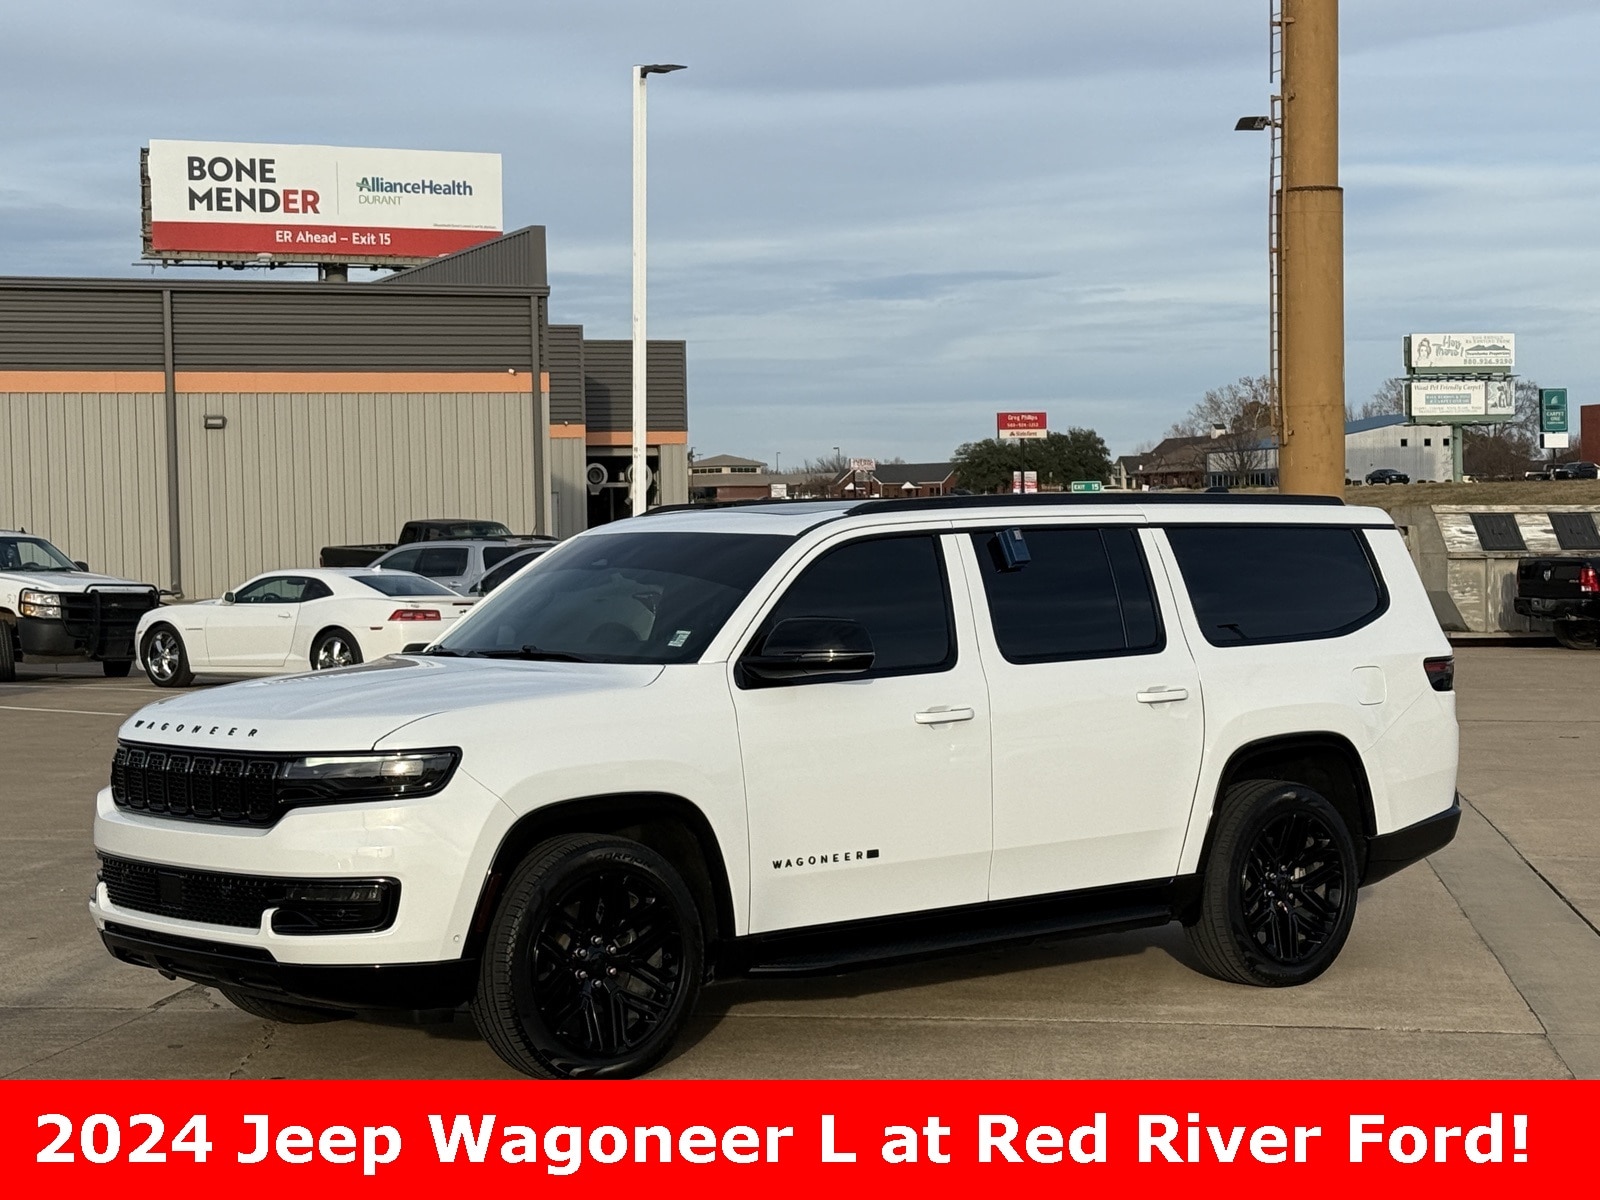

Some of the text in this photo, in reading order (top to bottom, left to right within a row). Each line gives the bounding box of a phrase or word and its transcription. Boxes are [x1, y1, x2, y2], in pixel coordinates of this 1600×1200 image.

[187, 156, 276, 183] BONE
[356, 177, 473, 196] AllianceHealth
[188, 187, 320, 214] MENDER
[358, 194, 403, 205] DURANT
[275, 230, 292, 243] ER
[296, 230, 337, 244] Ahead
[352, 232, 376, 245] Exit
[379, 232, 391, 245] 15
[1007, 414, 1020, 422] Greg
[134, 720, 258, 737] WAGONEER
[772, 851, 863, 869] WAGONEER
